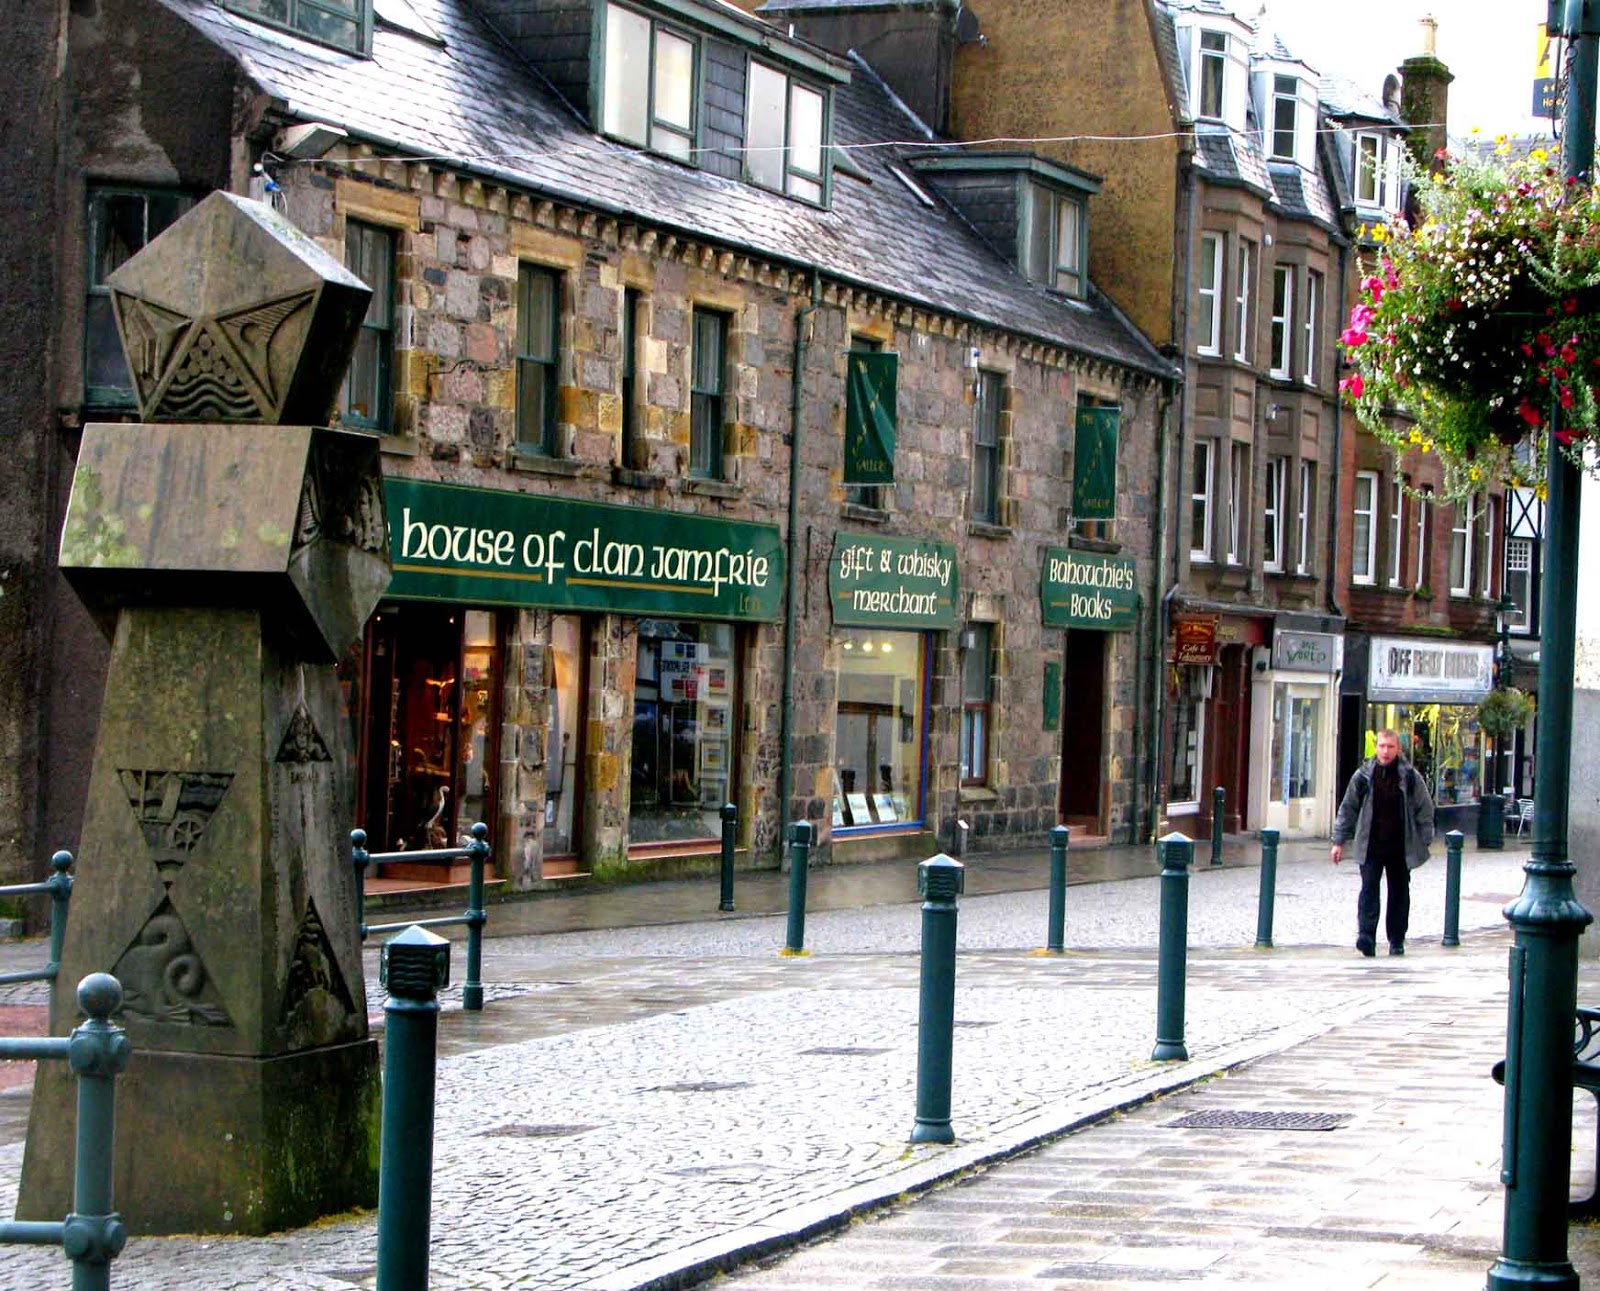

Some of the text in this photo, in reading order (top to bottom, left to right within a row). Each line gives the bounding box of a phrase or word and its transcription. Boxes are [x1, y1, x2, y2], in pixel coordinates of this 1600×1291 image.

[401, 507, 516, 566] house
[522, 529, 566, 585] of
[573, 526, 644, 578] clan
[840, 544, 952, 587] gift & whisky
[853, 585, 938, 615] merchant
[1070, 590, 1112, 620] Books
